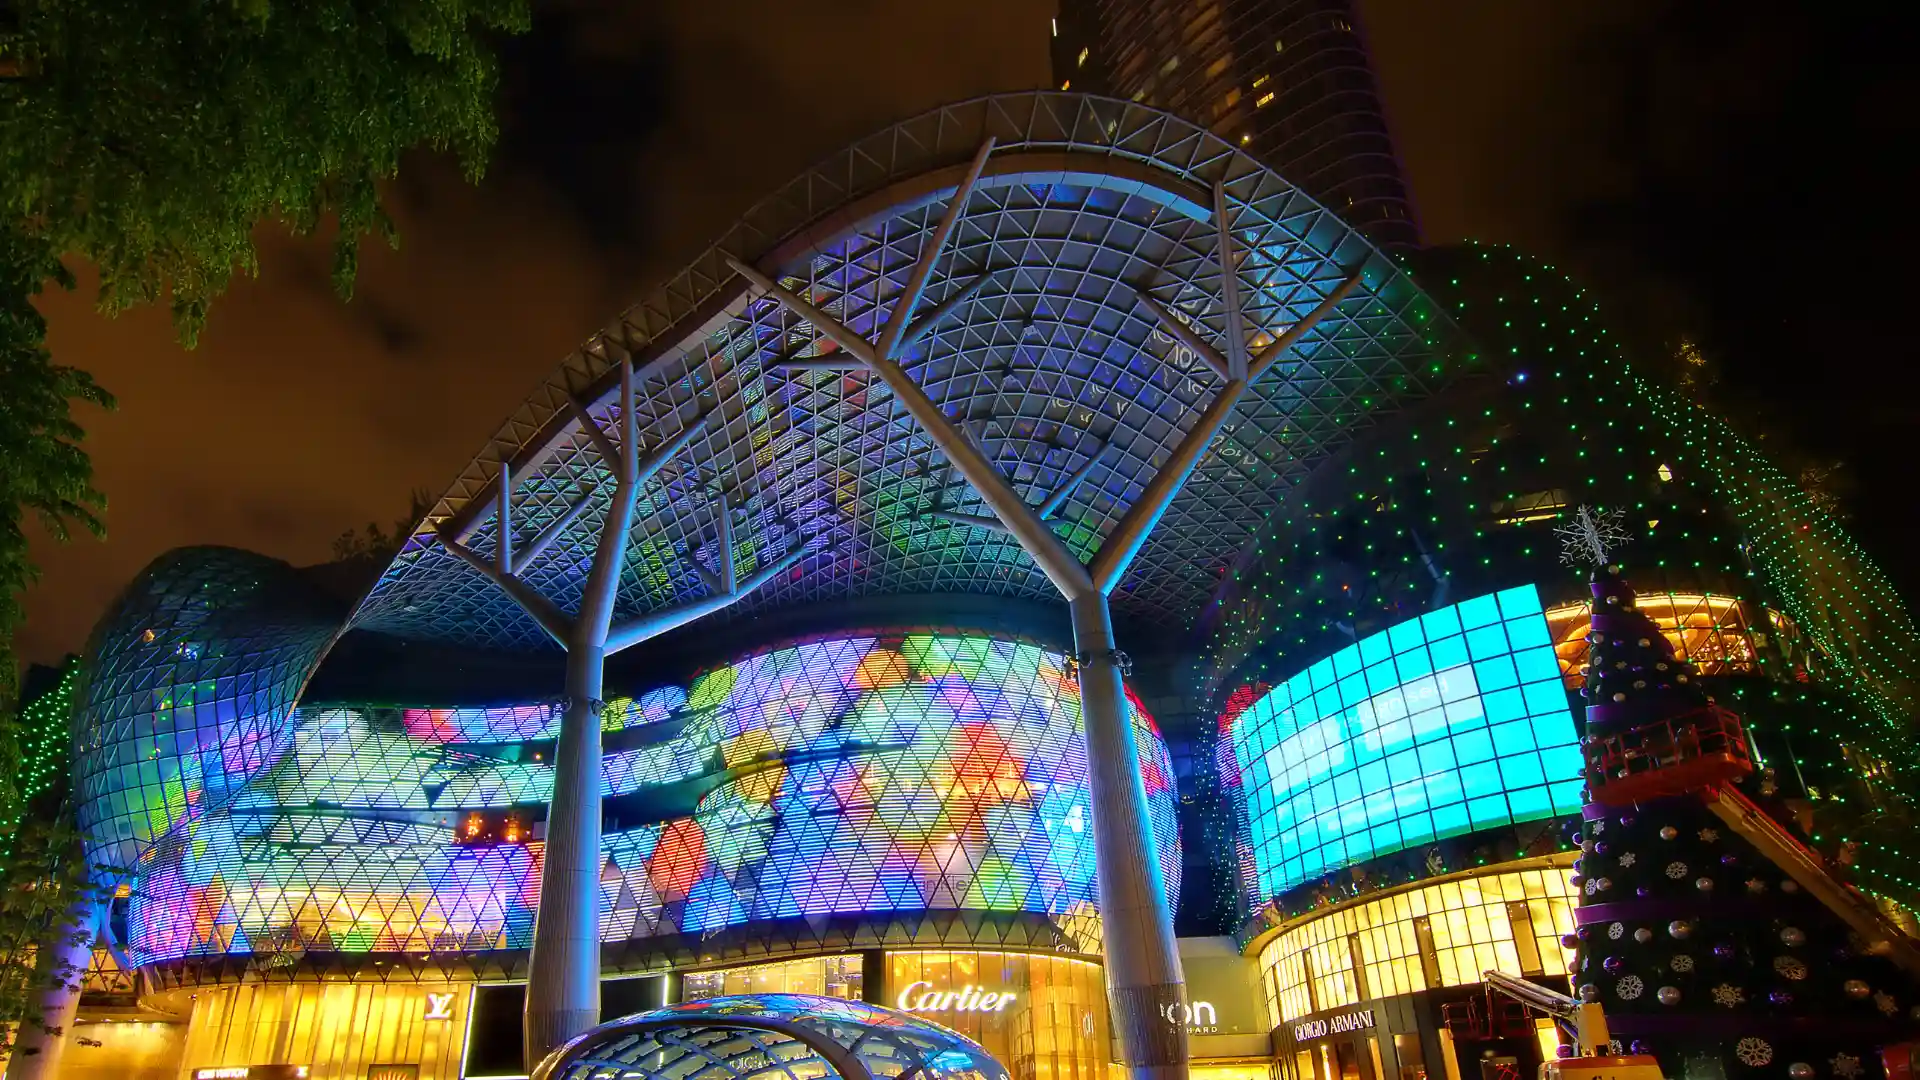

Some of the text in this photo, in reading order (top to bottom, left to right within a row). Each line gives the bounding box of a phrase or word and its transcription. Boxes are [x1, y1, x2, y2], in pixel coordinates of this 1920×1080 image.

[897, 980, 1017, 1012] Cartier
[1295, 1010, 1374, 1042] GIORGIO ARMANI
